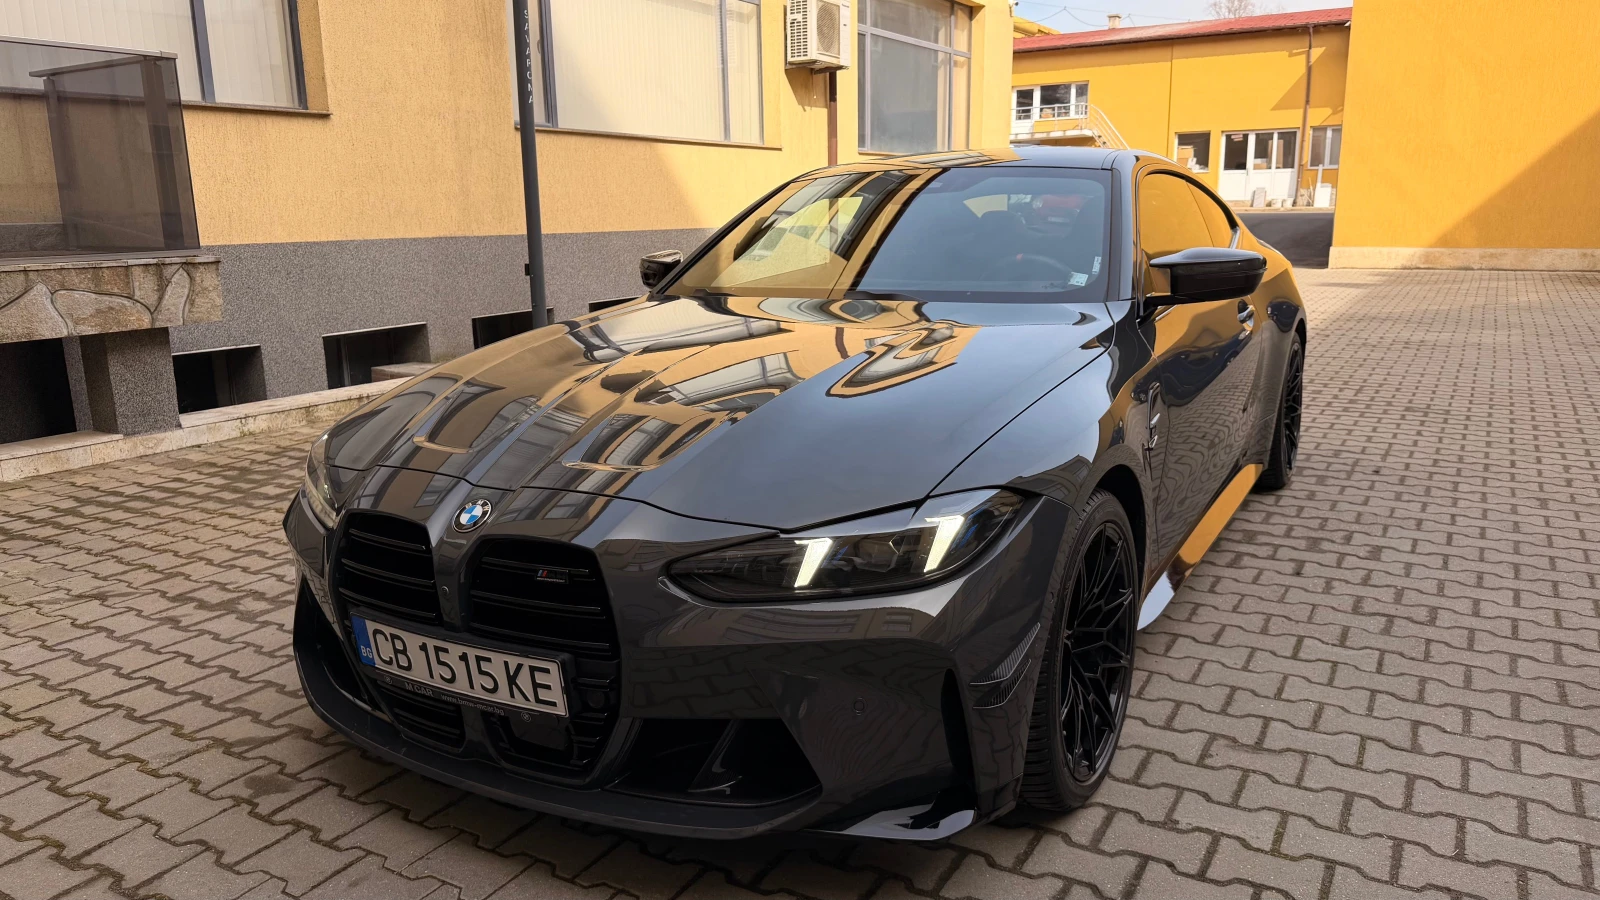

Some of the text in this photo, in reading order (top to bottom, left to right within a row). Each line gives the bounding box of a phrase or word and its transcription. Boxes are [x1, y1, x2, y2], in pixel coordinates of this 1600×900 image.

[361, 645, 373, 658] BG
[372, 628, 558, 708] CB 1515 KE
